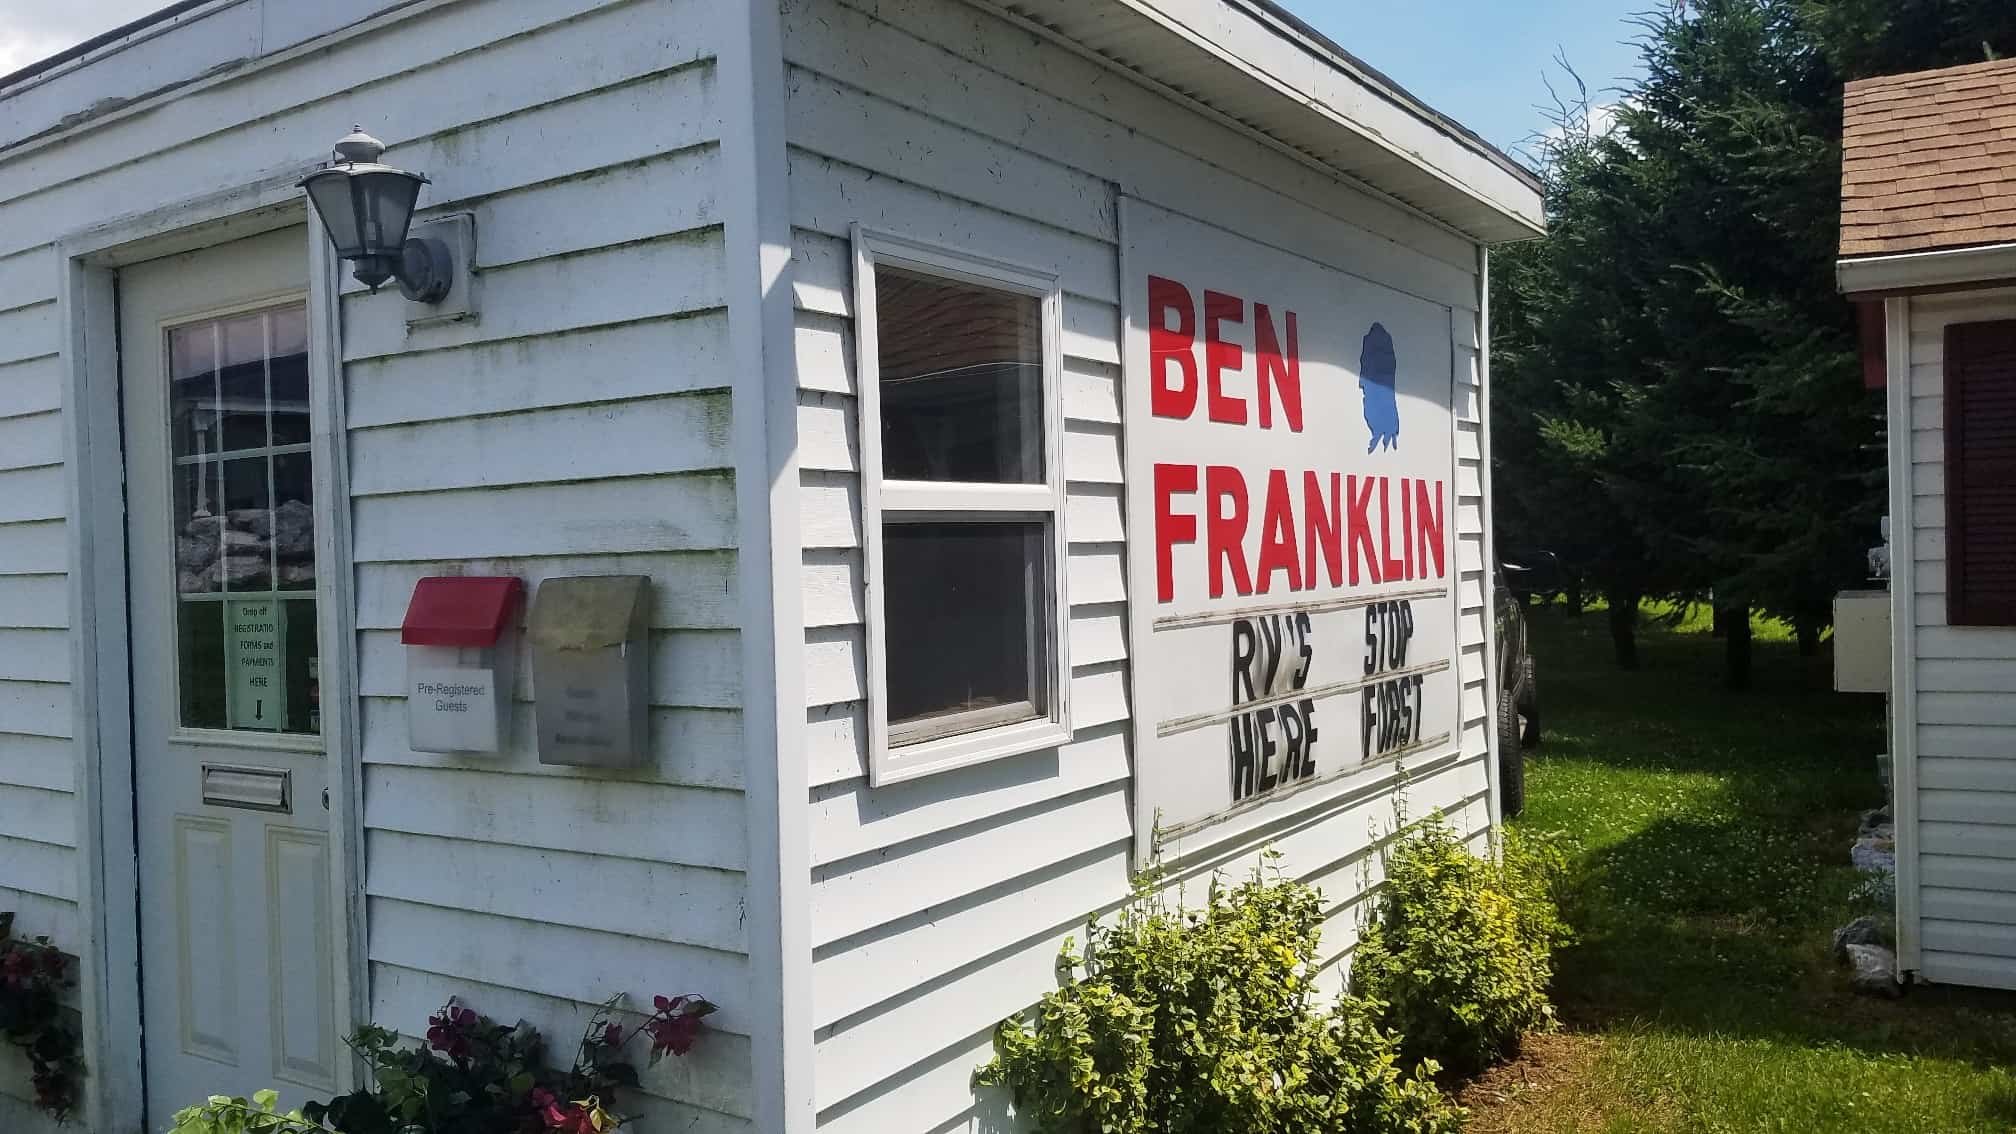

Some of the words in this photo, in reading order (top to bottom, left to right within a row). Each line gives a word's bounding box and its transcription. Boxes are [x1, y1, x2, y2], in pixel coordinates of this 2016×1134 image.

[1148, 275, 1303, 433] BEN
[1153, 463, 1445, 604] FRANKLIN
[242, 607, 257, 617] Drop
[259, 606, 267, 616] off
[234, 623, 274, 633] REGISTRATIO
[240, 640, 262, 650] FORMS
[1232, 611, 1313, 706] RV'S
[1363, 599, 1414, 675] STOP
[241, 657, 274, 667] PAYMENTS
[249, 676, 268, 688] HERE
[417, 682, 485, 697] Pre-Registered
[435, 700, 468, 713] Guests
[1230, 698, 1319, 801] HERE
[1361, 673, 1424, 760] FIRST
